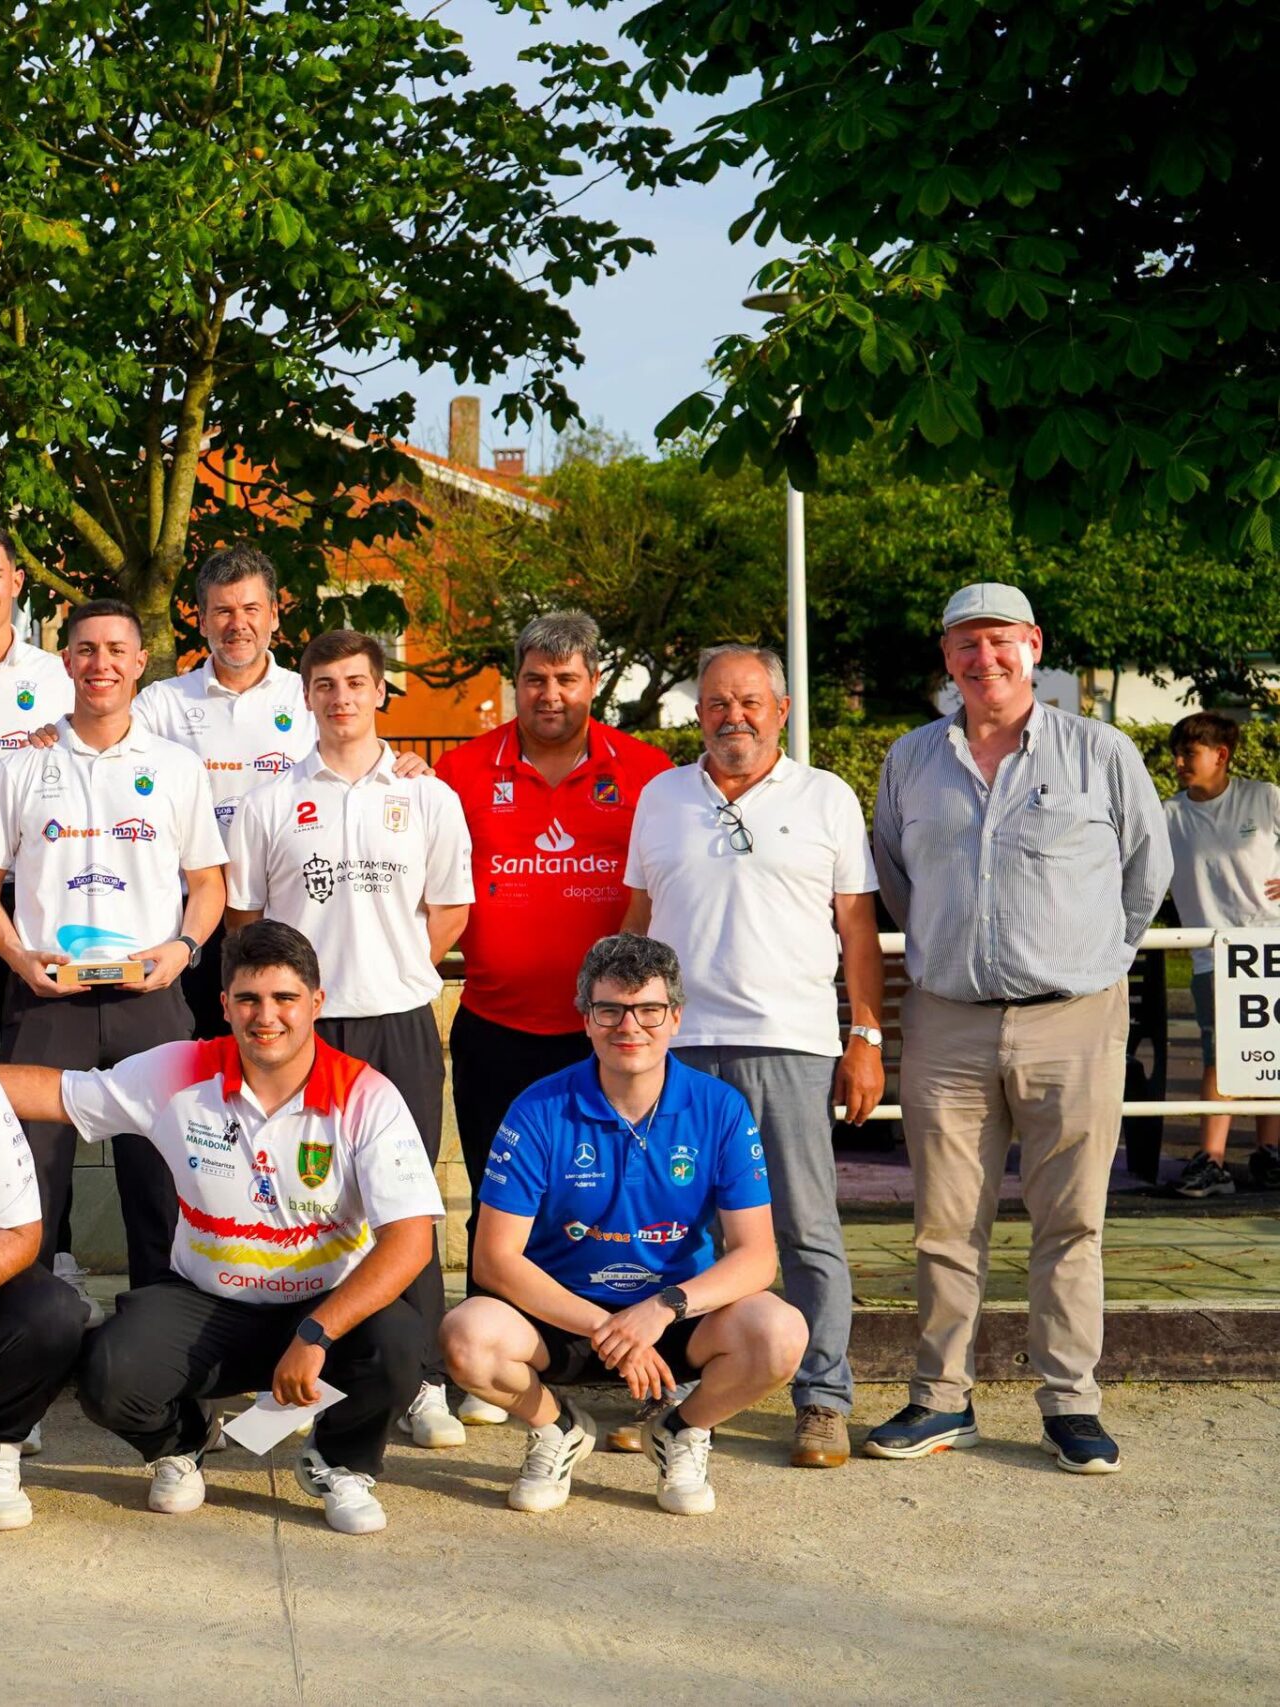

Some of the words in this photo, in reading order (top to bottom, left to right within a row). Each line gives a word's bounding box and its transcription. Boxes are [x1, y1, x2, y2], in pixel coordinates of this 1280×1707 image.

[254, 752, 295, 775] mayb
[296, 801, 318, 825] 2
[112, 818, 157, 843] mayba
[490, 853, 619, 874] Santander
[563, 884, 619, 902] deporte
[1241, 1050, 1276, 1062] USO
[1255, 1069, 1280, 1081] JU
[185, 1134, 232, 1152] MARADONA
[288, 1195, 339, 1215] bathco
[218, 1271, 324, 1293] cantabria
